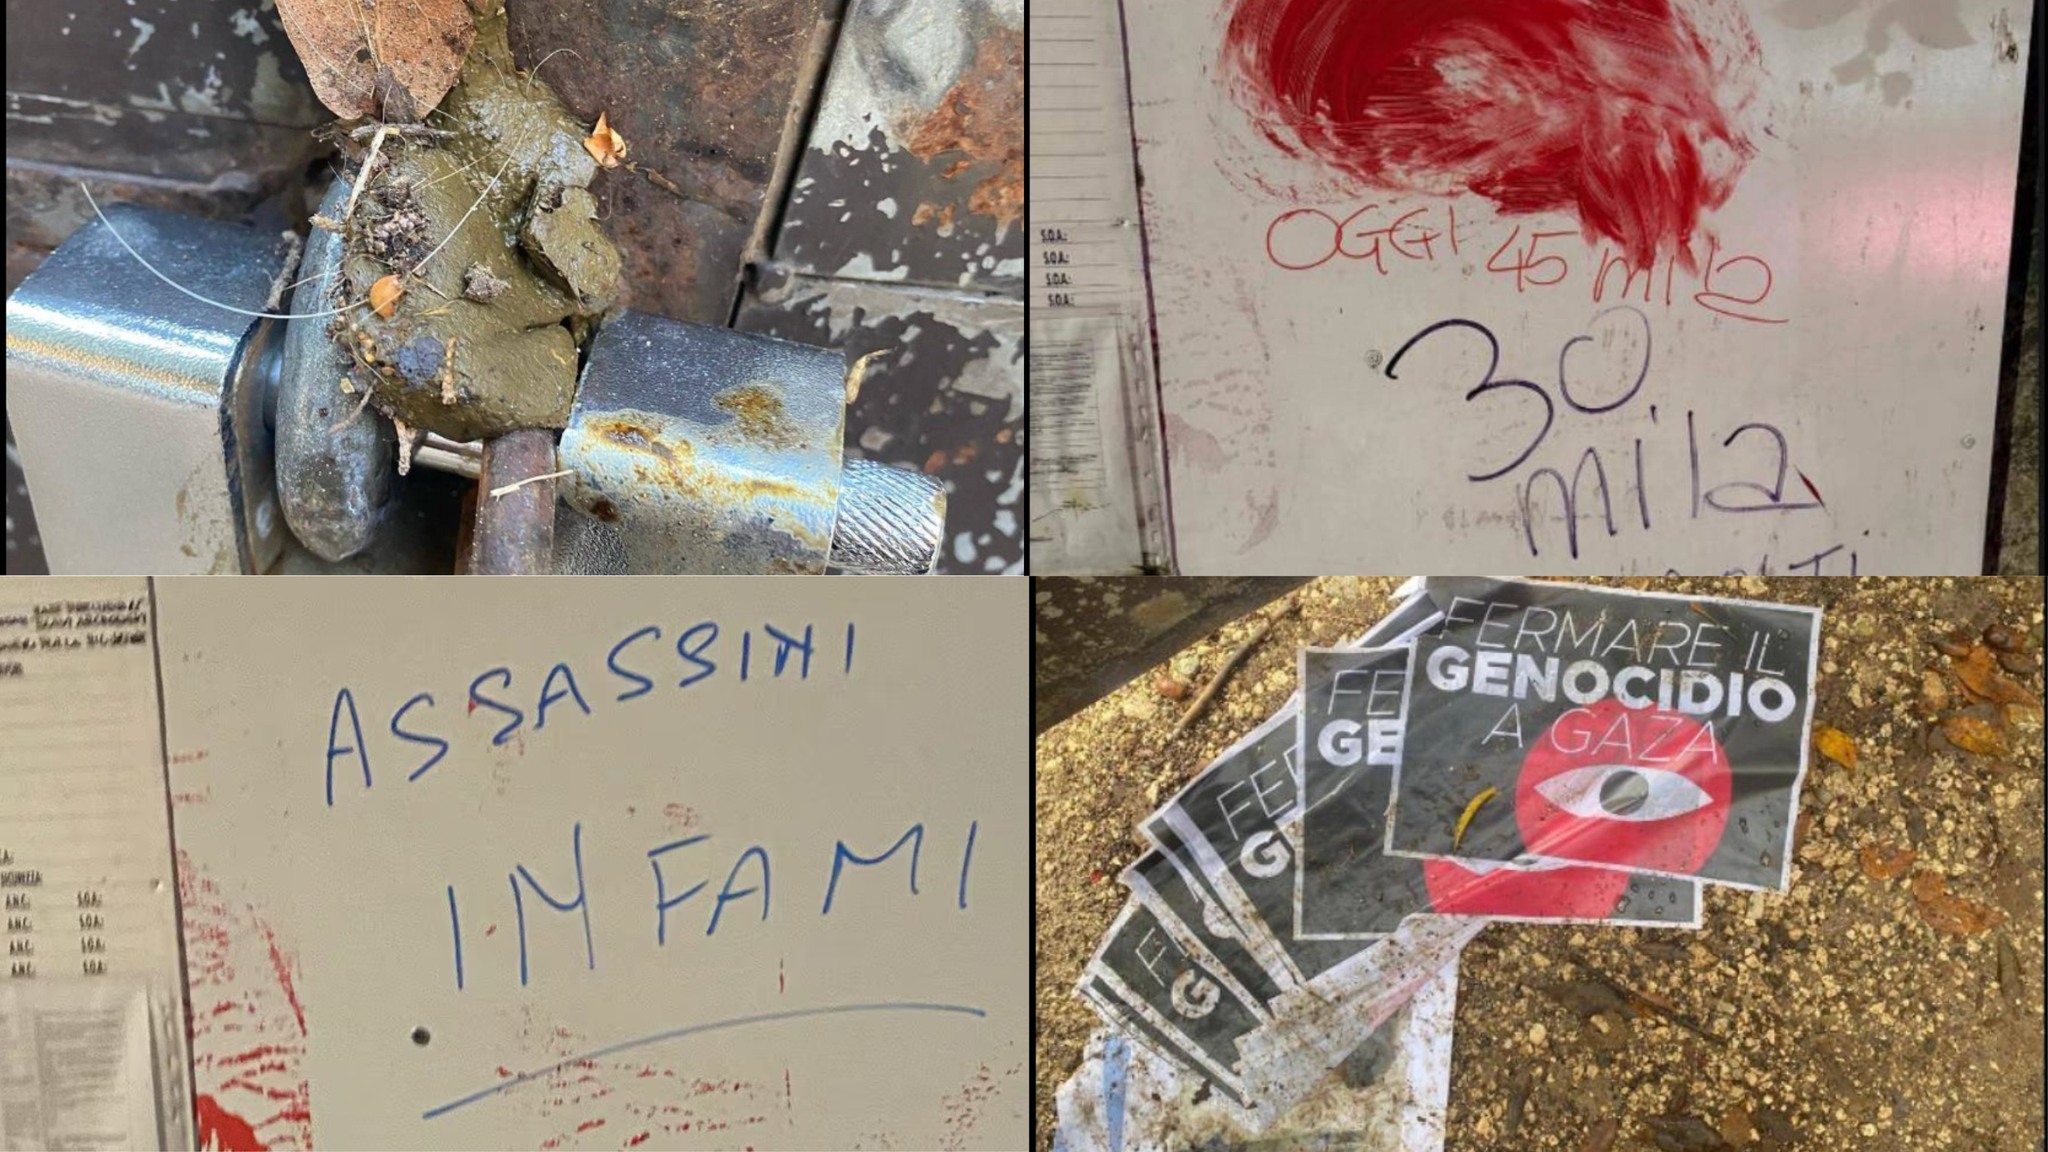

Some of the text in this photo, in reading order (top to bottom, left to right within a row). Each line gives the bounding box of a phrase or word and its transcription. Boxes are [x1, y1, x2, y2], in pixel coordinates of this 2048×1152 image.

[1266, 204, 1458, 276] OGGI
[1486, 224, 1580, 292] 45
[1439, 596, 1786, 677] FERMARE IL
[326, 622, 856, 806] ASSASSINI
[1425, 645, 1797, 723] GENOCIDIO
[1481, 702, 1718, 765] A GAZA
